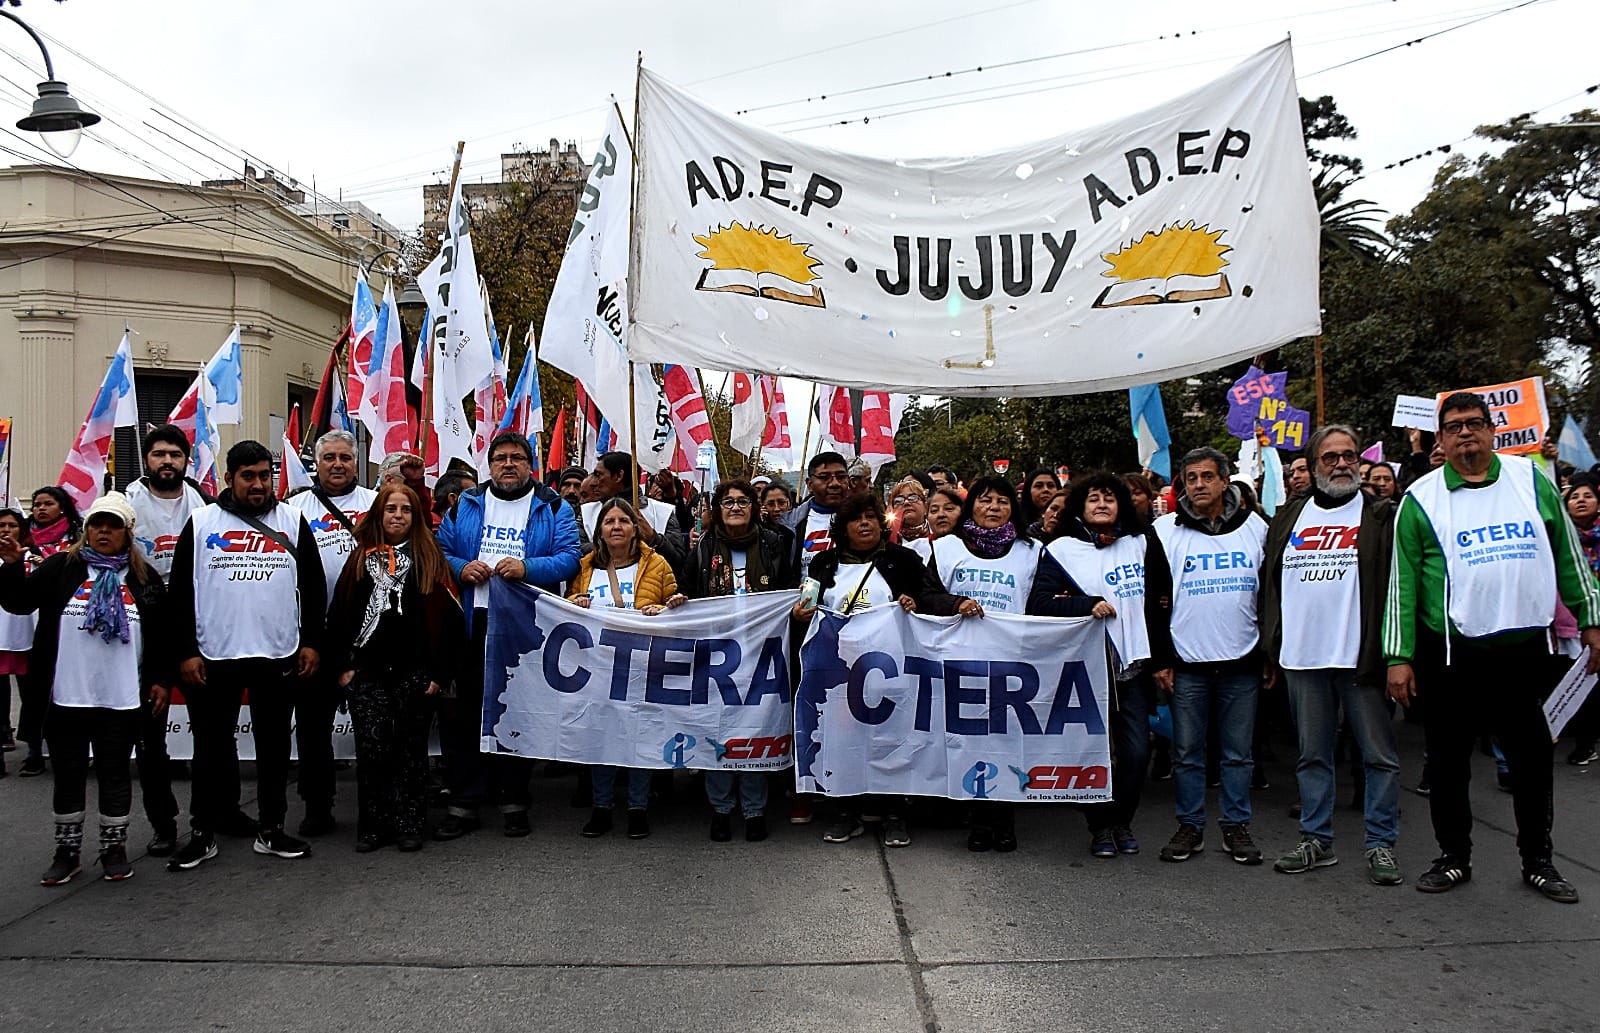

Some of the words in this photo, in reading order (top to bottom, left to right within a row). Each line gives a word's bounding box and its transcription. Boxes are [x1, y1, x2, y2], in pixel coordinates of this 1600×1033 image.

[875, 229, 1077, 301] JUJUY
[1231, 375, 1275, 406] ESC
[1271, 419, 1303, 447] 14
[1295, 525, 1360, 551] CTA
[1456, 520, 1537, 548] CTERA
[1285, 554, 1307, 562] Central
[228, 570, 274, 581] JUJUY
[955, 568, 1015, 589] CTERA
[1300, 569, 1347, 582] JUJUY
[542, 621, 790, 706] CTERA
[846, 651, 1108, 736] CTERA
[722, 733, 793, 760] CTA
[722, 761, 733, 769] de
[1025, 765, 1108, 790] CTA
[1053, 792, 1108, 801] trabajadores
